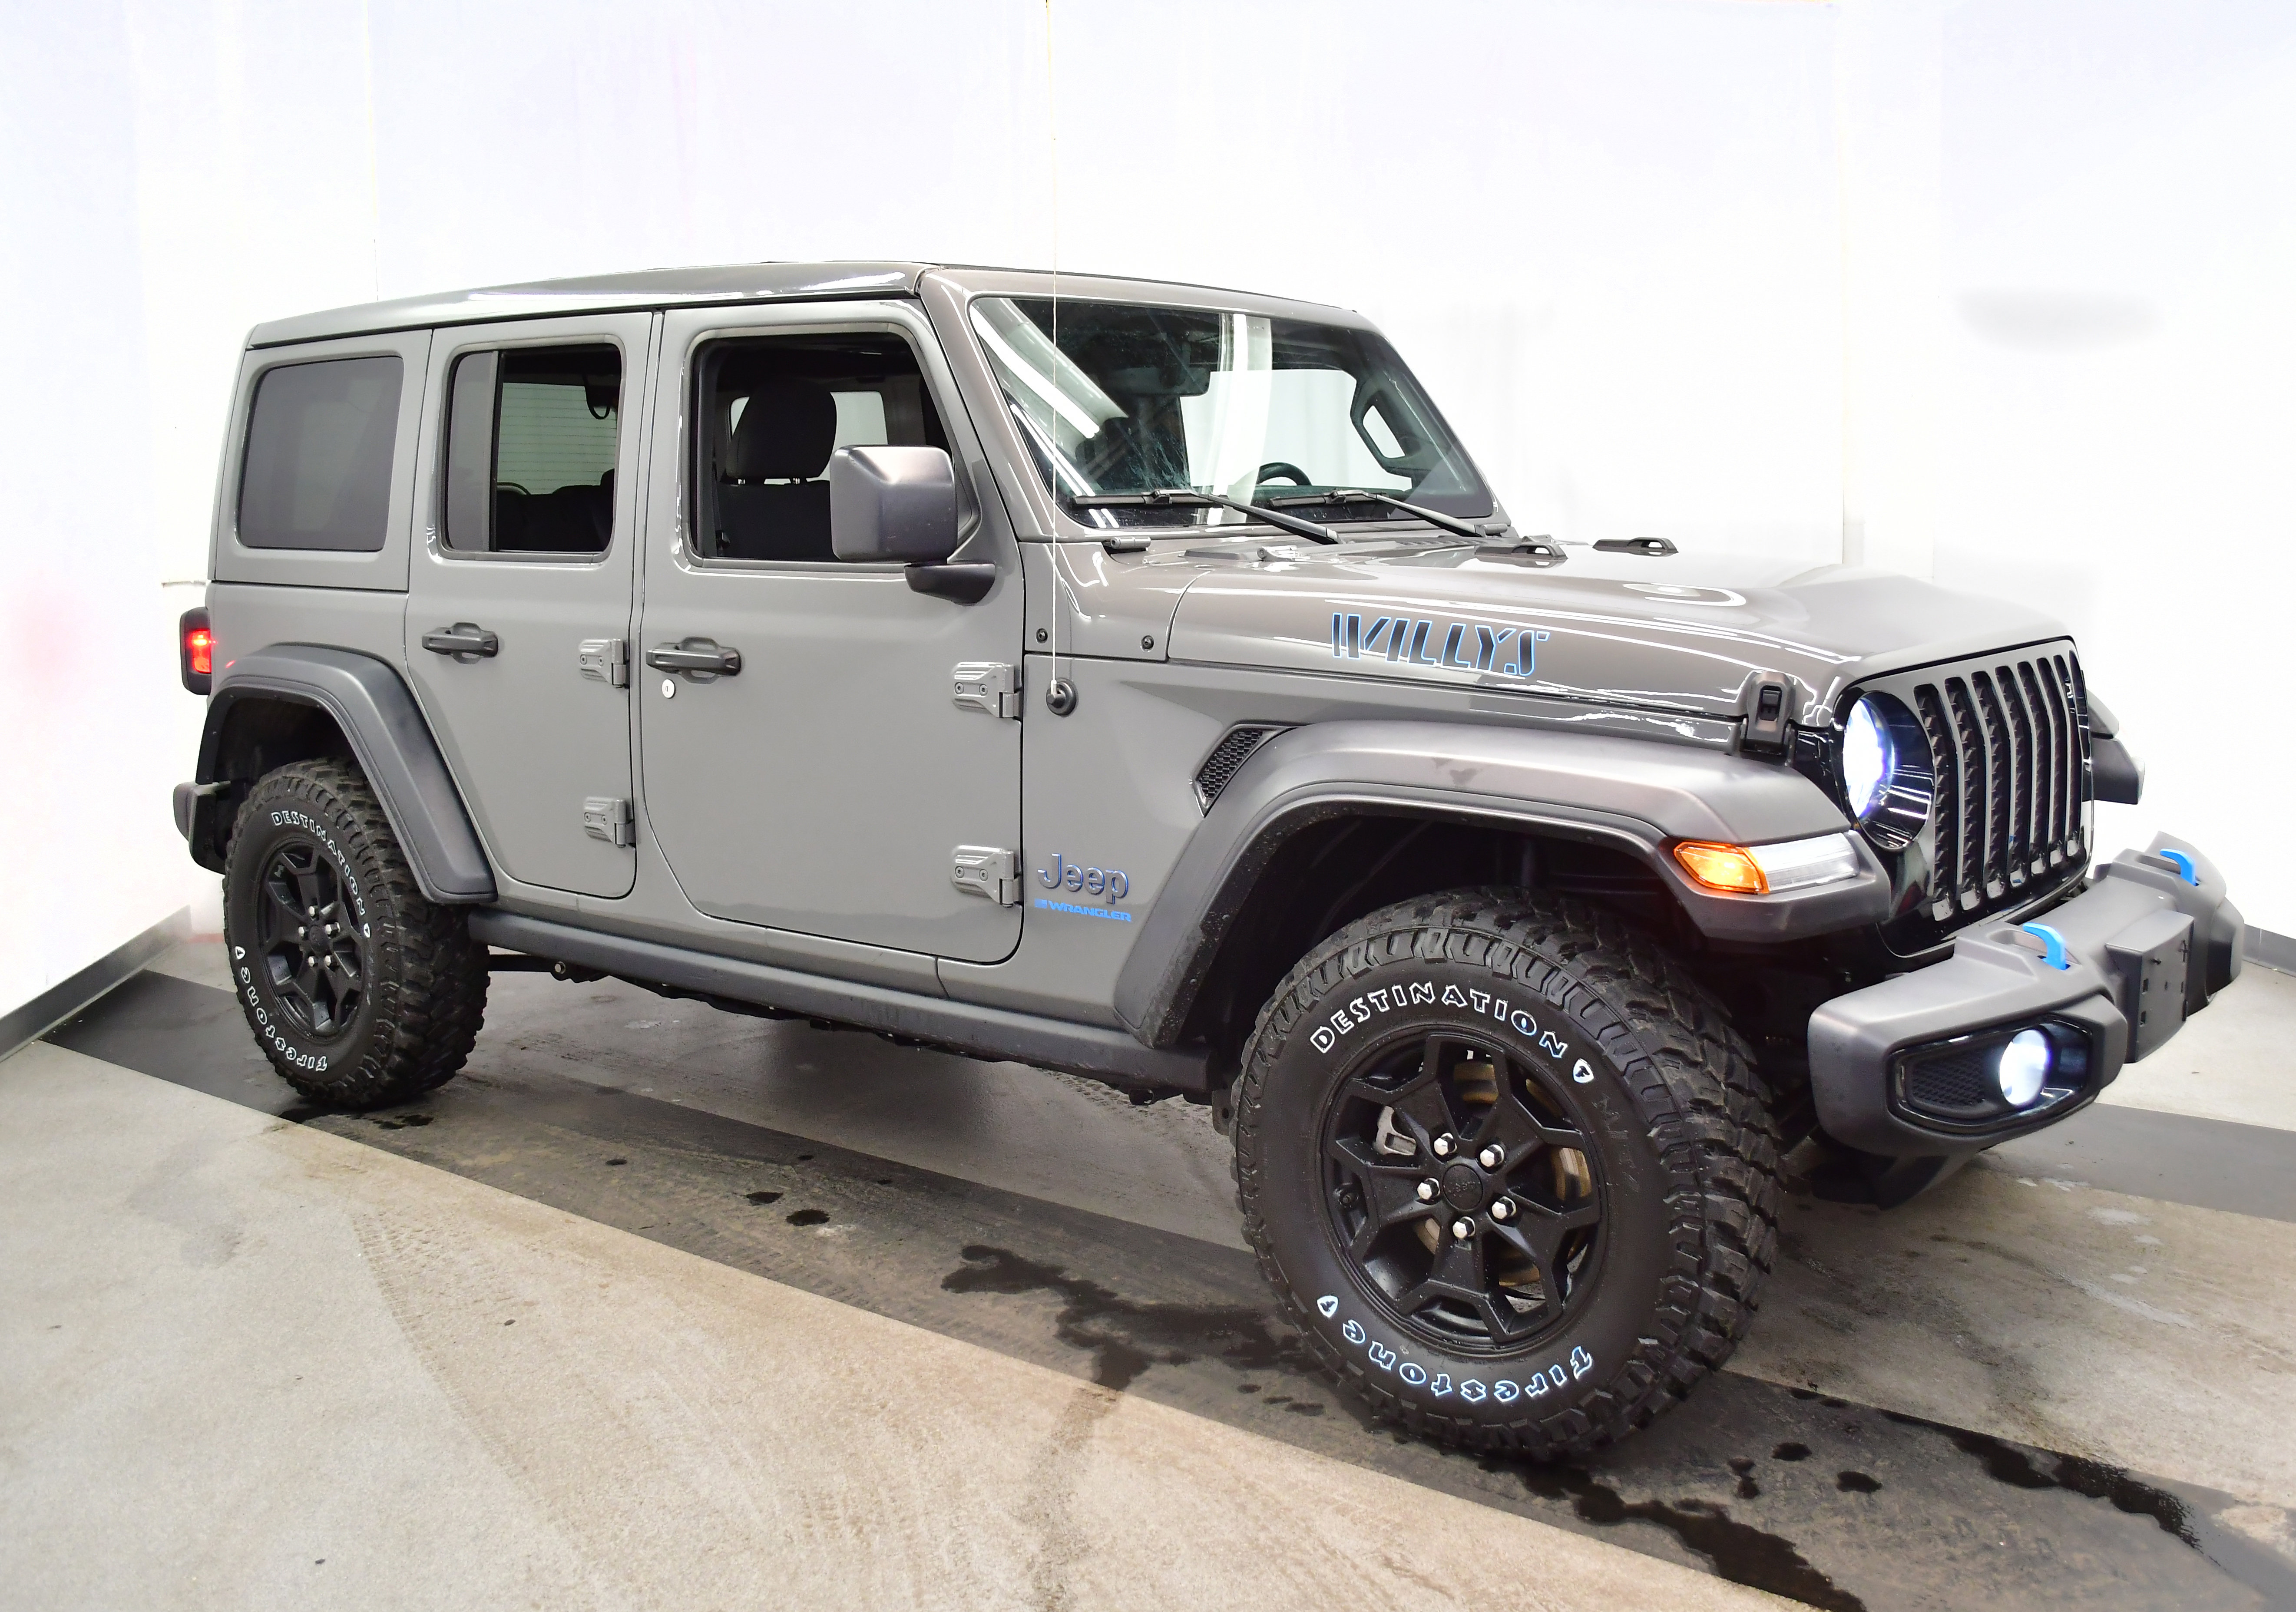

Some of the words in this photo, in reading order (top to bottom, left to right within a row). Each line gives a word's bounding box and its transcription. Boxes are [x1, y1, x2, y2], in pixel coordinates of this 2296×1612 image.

[1332, 612, 1550, 677] WILLYS
[271, 810, 366, 916] DESTINATION
[1038, 853, 1129, 905] Jeep
[1048, 900, 1131, 922] WRANGLER
[1309, 981, 1568, 1059] DESTINATION
[1342, 1319, 1594, 1403] Firestone
